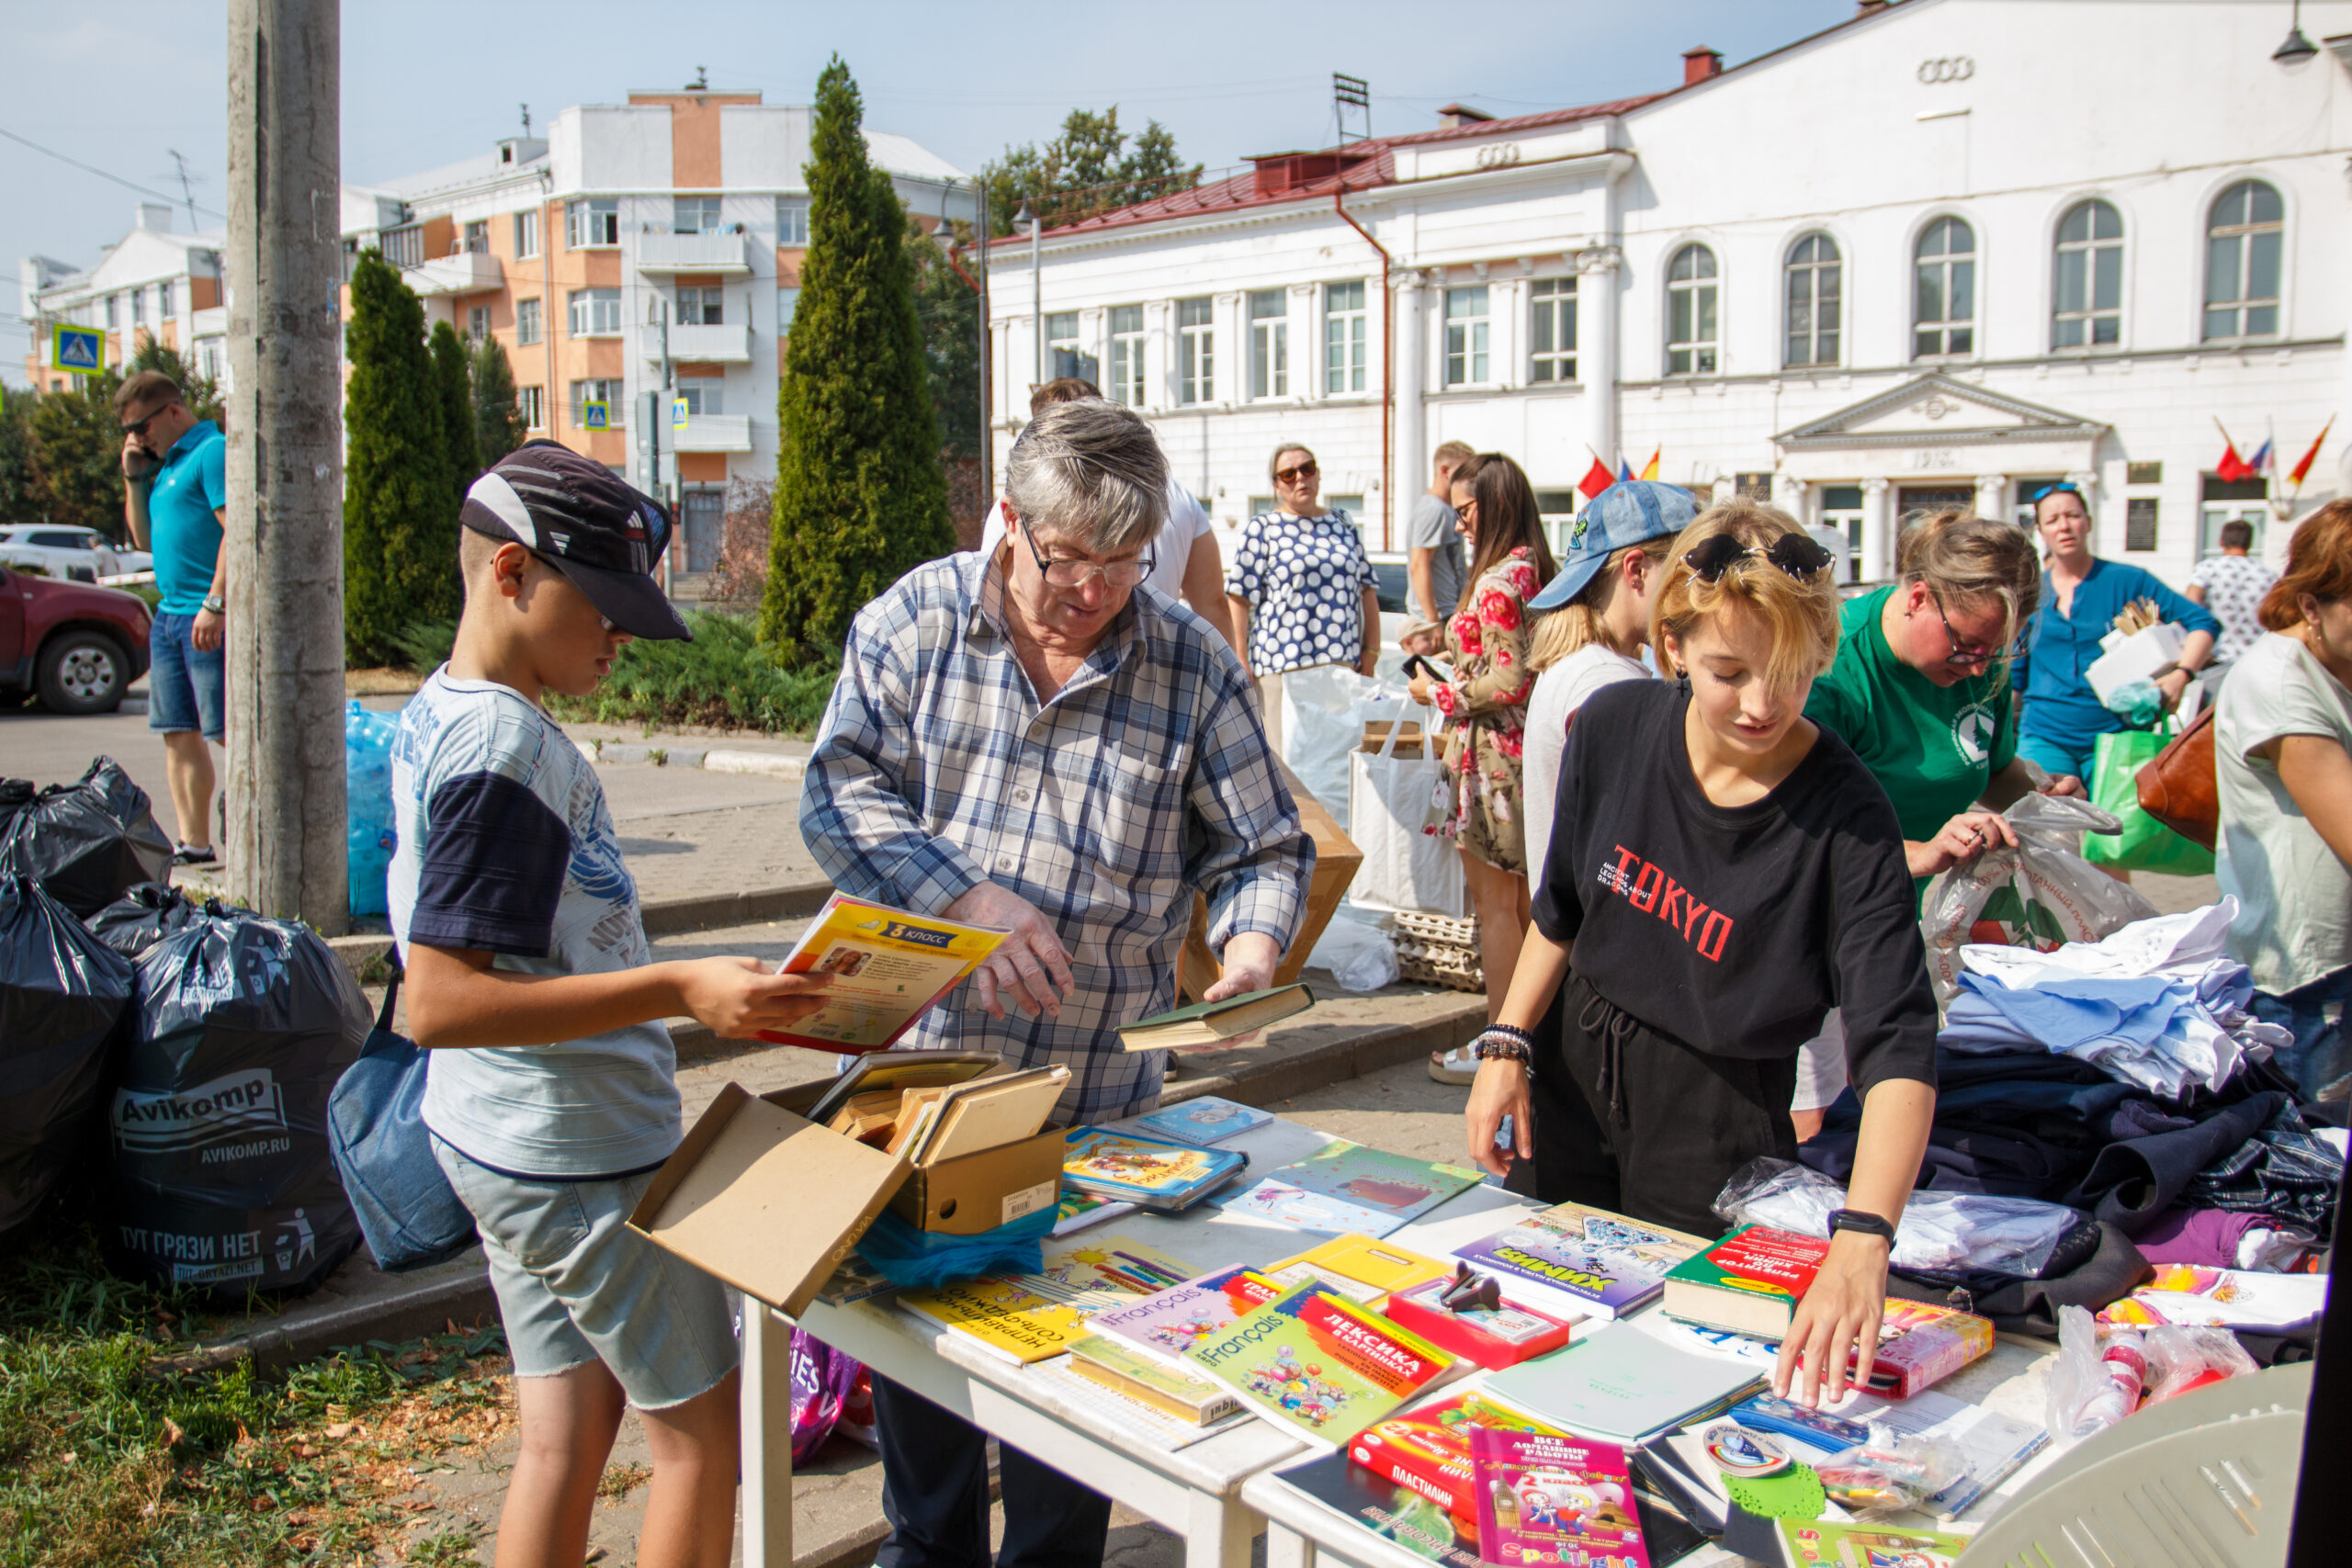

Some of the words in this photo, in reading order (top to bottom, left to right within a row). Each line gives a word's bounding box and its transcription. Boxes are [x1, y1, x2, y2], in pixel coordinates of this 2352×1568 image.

[1597, 874, 1629, 897] DRAGONS
[1600, 867, 1628, 889] LEGENDS
[1628, 885, 1653, 900] ABOUT
[1602, 861, 1630, 881] ANCIENT
[1614, 844, 1735, 962] TOKYO
[889, 922, 907, 938] 3
[122, 1078, 265, 1122] Avikomp
[201, 1137, 291, 1164] AVIKOMP.RU
[856, 1215, 874, 1235] VIA
[119, 1226, 148, 1253] ТУТ
[153, 1231, 214, 1260] ГРЯЗИ
[223, 1230, 262, 1259] НЕТ
[831, 1232, 858, 1263] UNO
[1492, 1245, 1617, 1292] ХИМИЯ
[1716, 1258, 1801, 1279] РЕПЕТИТОР
[928, 1292, 1047, 1348] НЕПРАВИЛЬНОЕ
[948, 1287, 1064, 1342] СОЛЬФЕДЖИО
[1107, 1288, 1202, 1325] Français
[1204, 1314, 1283, 1362] Français
[1324, 1313, 1421, 1372] ЛЕКСИКА
[1338, 1342, 1367, 1361] LEXIQUE
[1332, 1328, 1341, 1337] В
[1341, 1332, 1414, 1379] КАРТИНКАХ
[1335, 1351, 1356, 1366] POUR
[790, 1348, 820, 1394] IES
[1372, 1367, 1399, 1388] IMAGES
[1384, 1422, 1409, 1436] 12
[1533, 1436, 1565, 1447] ВСЕ
[1512, 1441, 1590, 1456] ДОМАШНИЕ
[1524, 1449, 1584, 1461] РАБОТЫ
[1392, 1465, 1453, 1506] ПЛАСТИЛИН
[1521, 1473, 1538, 1486] 2
[1361, 1506, 1459, 1556] РИСОВАНИЯ
[1555, 1541, 1580, 1550] ФГОС
